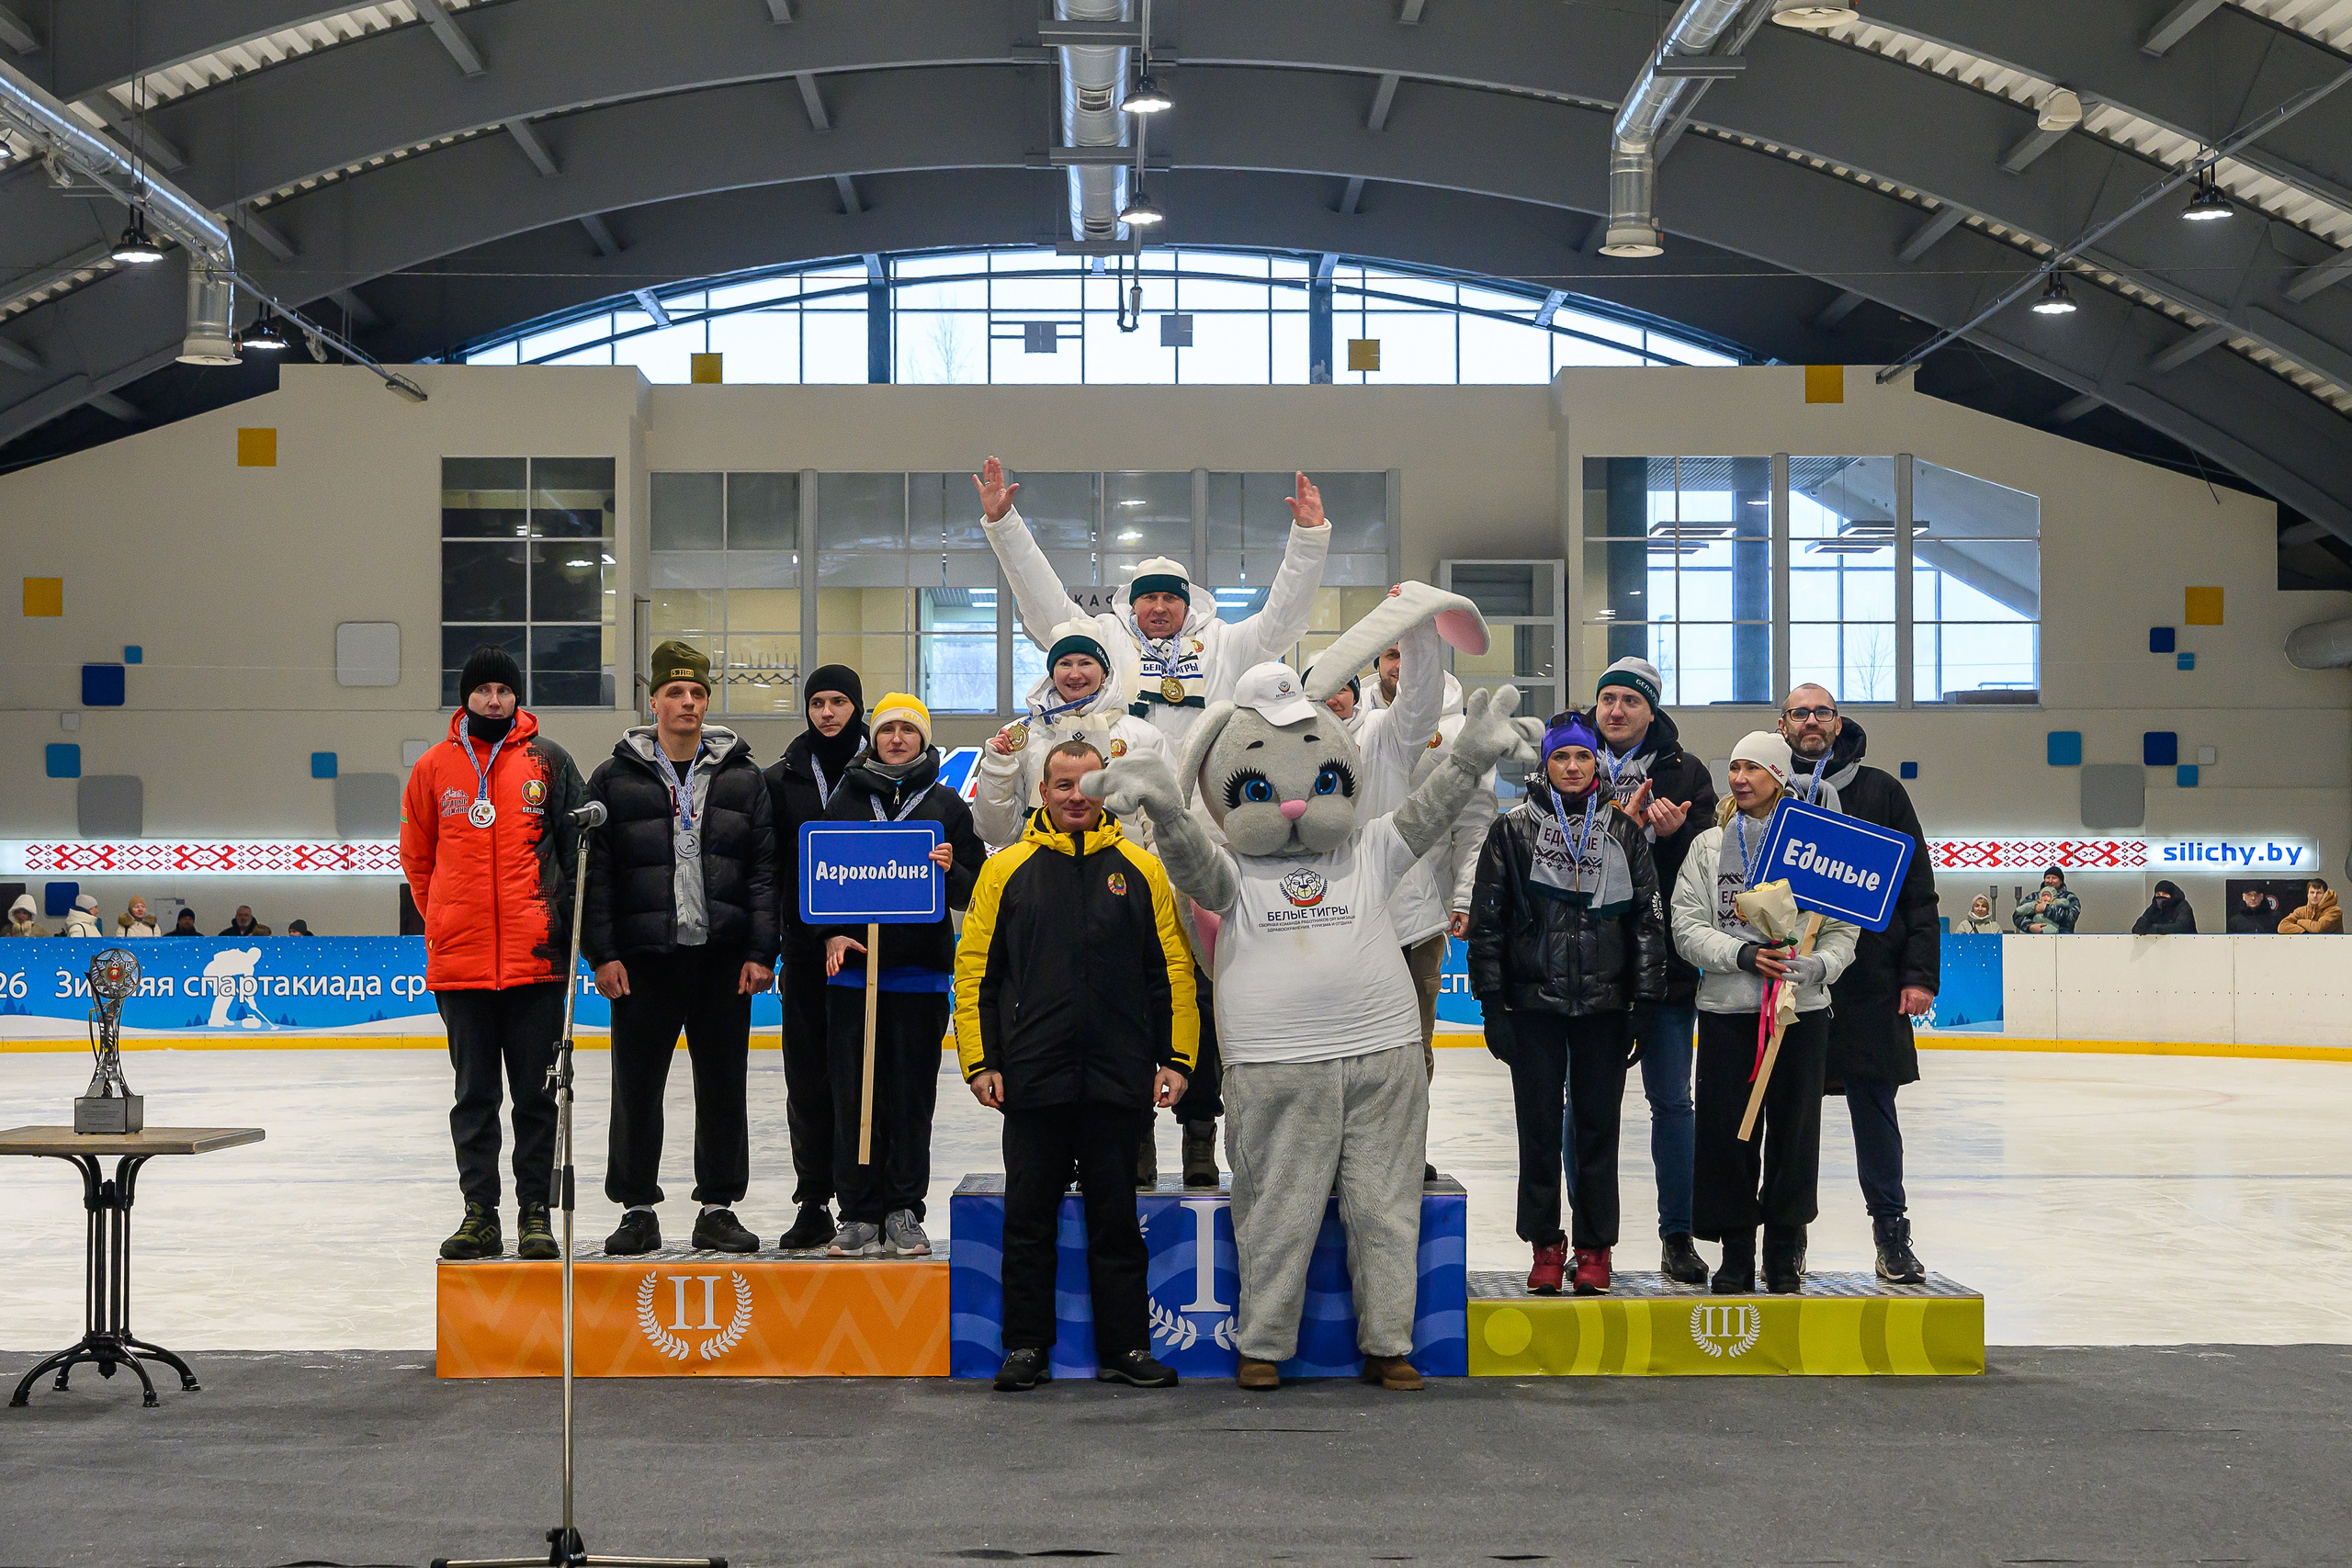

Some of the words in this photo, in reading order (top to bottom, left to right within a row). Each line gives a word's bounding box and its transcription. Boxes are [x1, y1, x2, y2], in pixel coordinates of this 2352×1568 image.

[1782, 838, 1881, 892] Единые
[2164, 842, 2303, 866] silichy.by
[815, 859, 929, 886] Агрохолдинг
[1267, 908, 1308, 921] БЕЛЫЕ
[1309, 905, 1349, 918] ТИГРЫ
[54, 970, 175, 998] Зияя
[184, 975, 382, 1003] спартакиада
[390, 975, 435, 1003] ср
[667, 1276, 722, 1330] II
[1702, 1306, 1749, 1337] III
